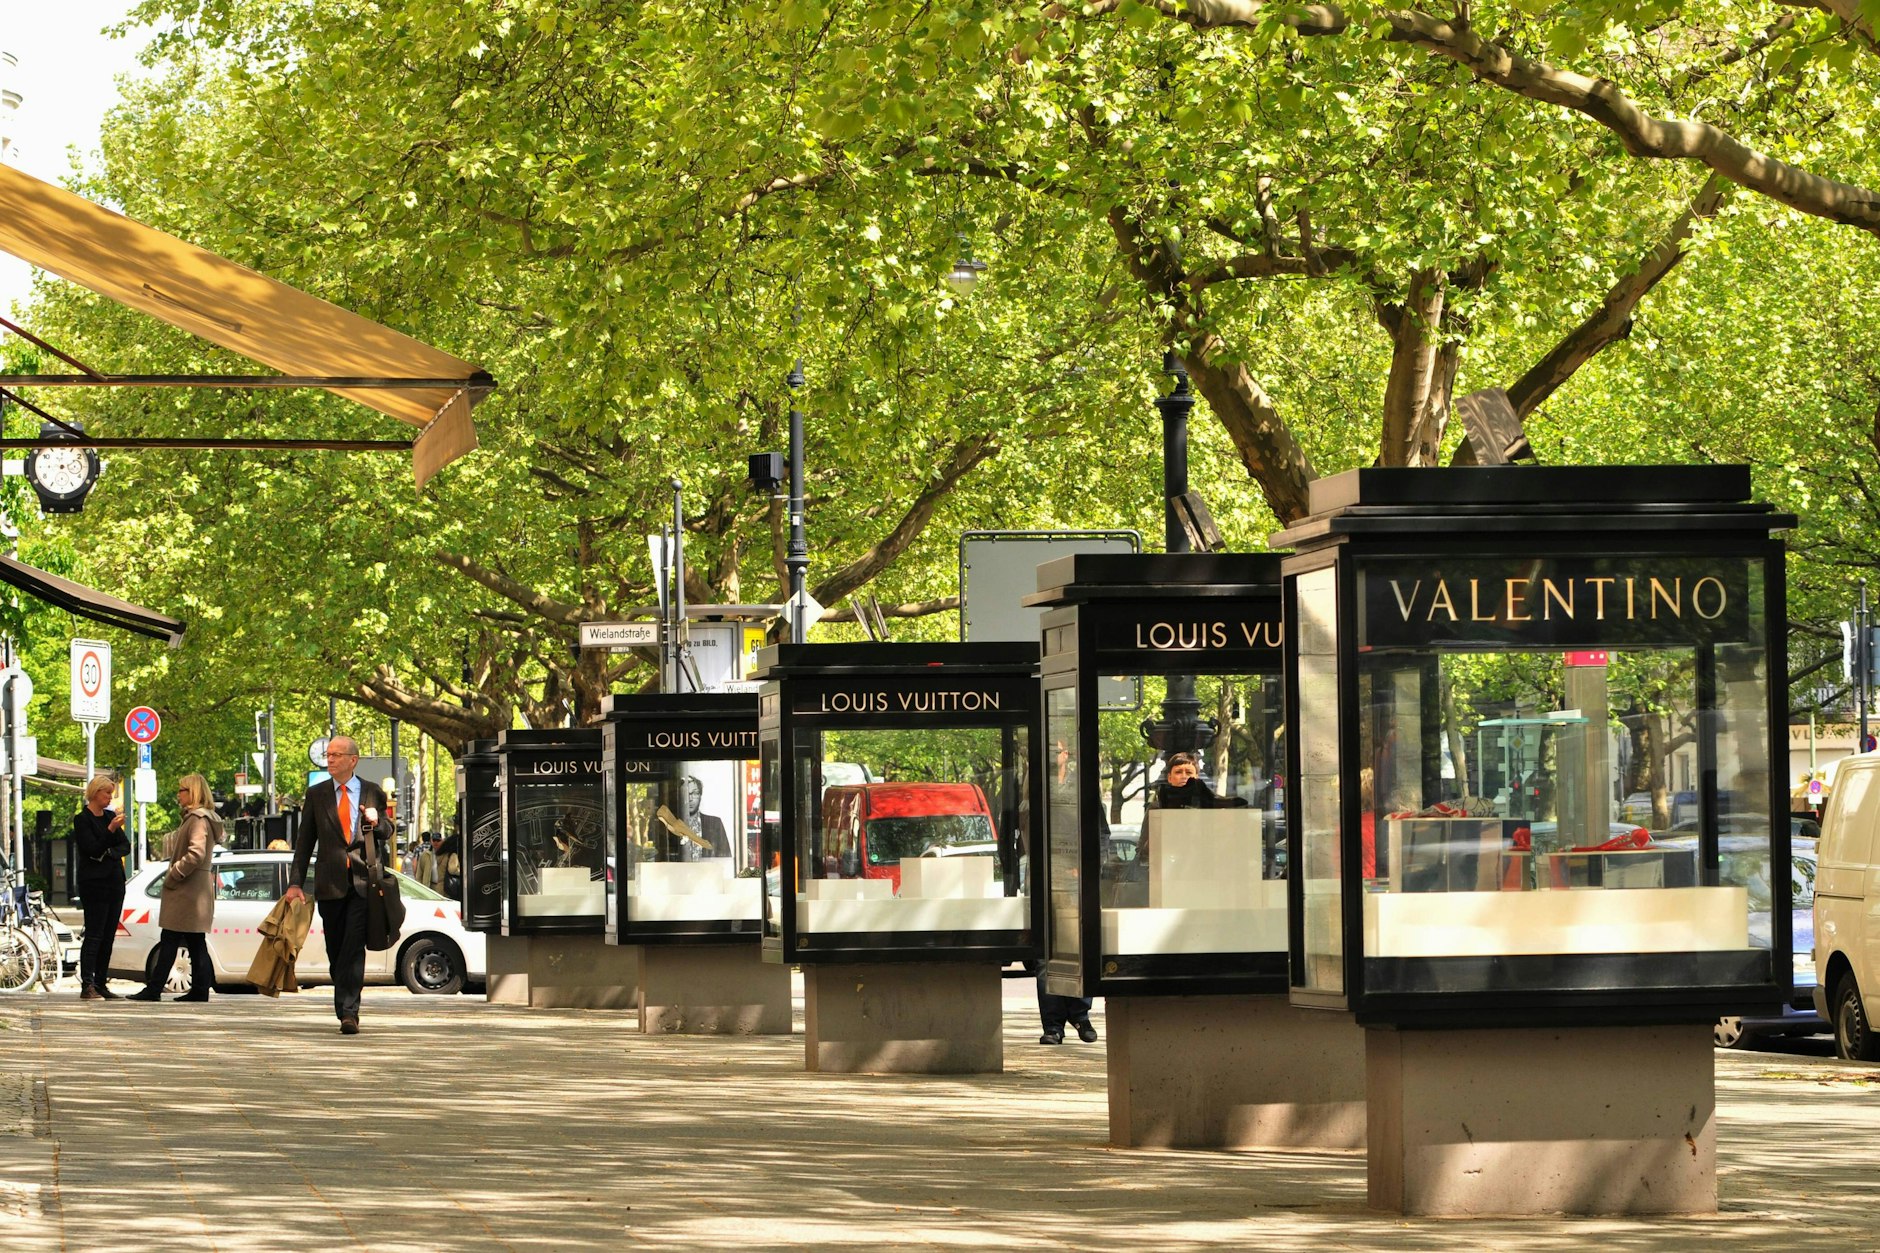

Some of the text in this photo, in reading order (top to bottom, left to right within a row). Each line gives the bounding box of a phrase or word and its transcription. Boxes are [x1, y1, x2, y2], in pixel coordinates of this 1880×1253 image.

[1389, 577, 1726, 622] VALENTINO
[590, 627, 650, 640] Wielandstraße
[1137, 622, 1283, 649] LOUIS VU
[85, 664, 97, 684] 30
[822, 691, 1000, 712] LOUIS VUITTON
[648, 731, 758, 748] LOUIS VUITT
[533, 760, 578, 774] LOUIS
[230, 889, 240, 897] Ort
